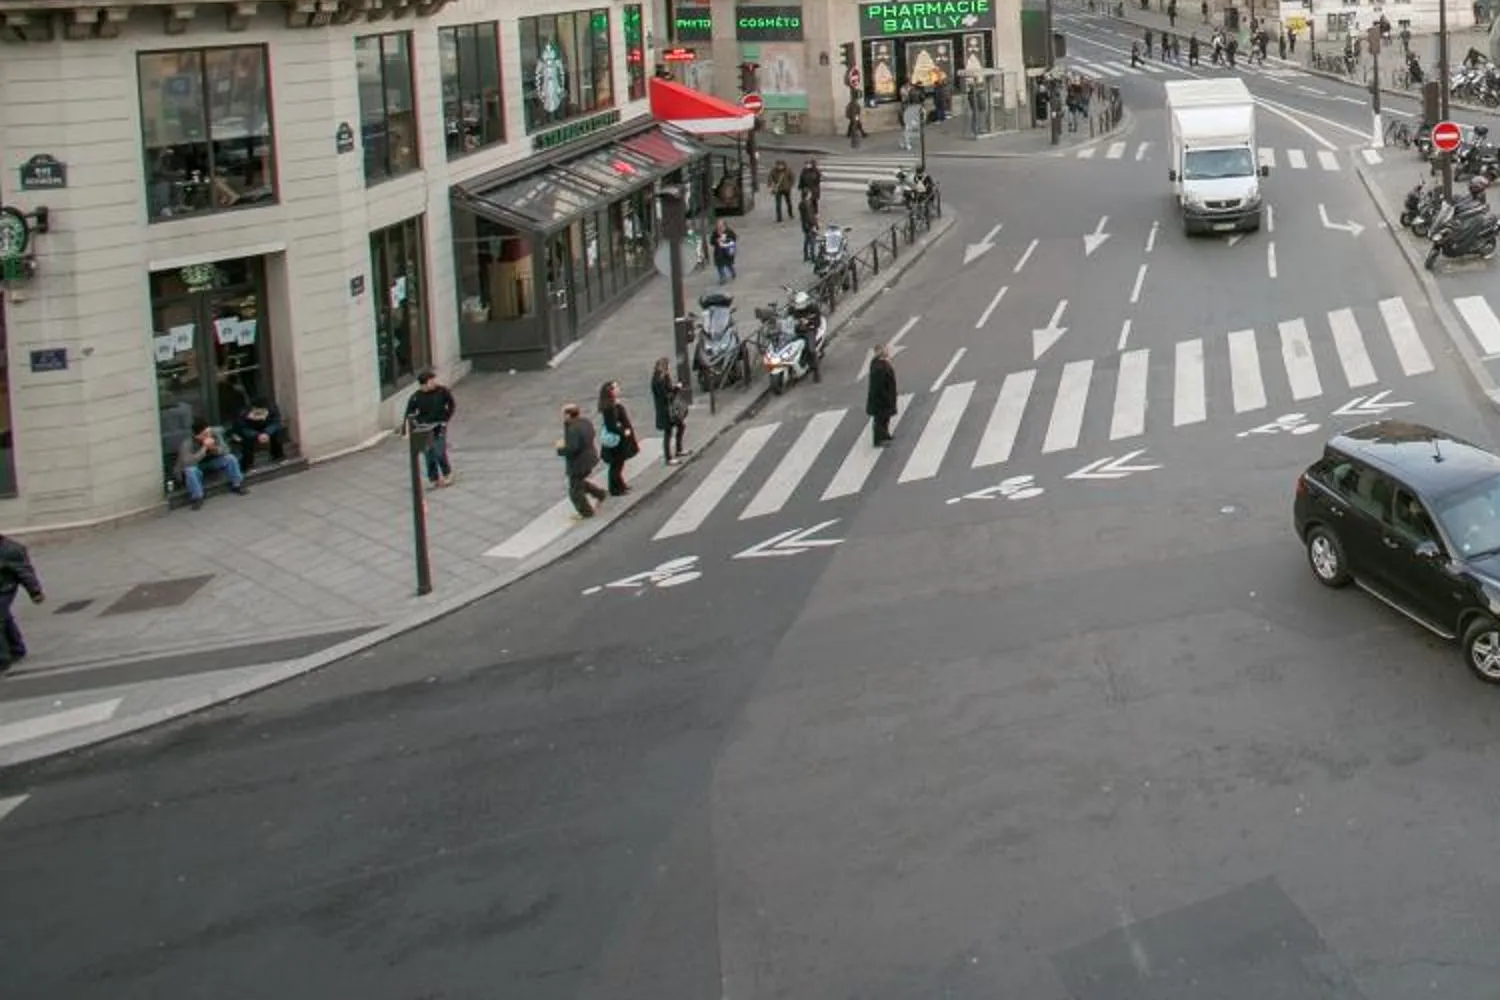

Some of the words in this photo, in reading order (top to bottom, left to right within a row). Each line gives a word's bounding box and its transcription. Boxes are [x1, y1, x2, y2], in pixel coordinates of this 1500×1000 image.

[868, 0, 989, 19] PHARMACIE
[738, 16, 801, 29] COSMÉTO
[883, 15, 961, 33] BAILLY
